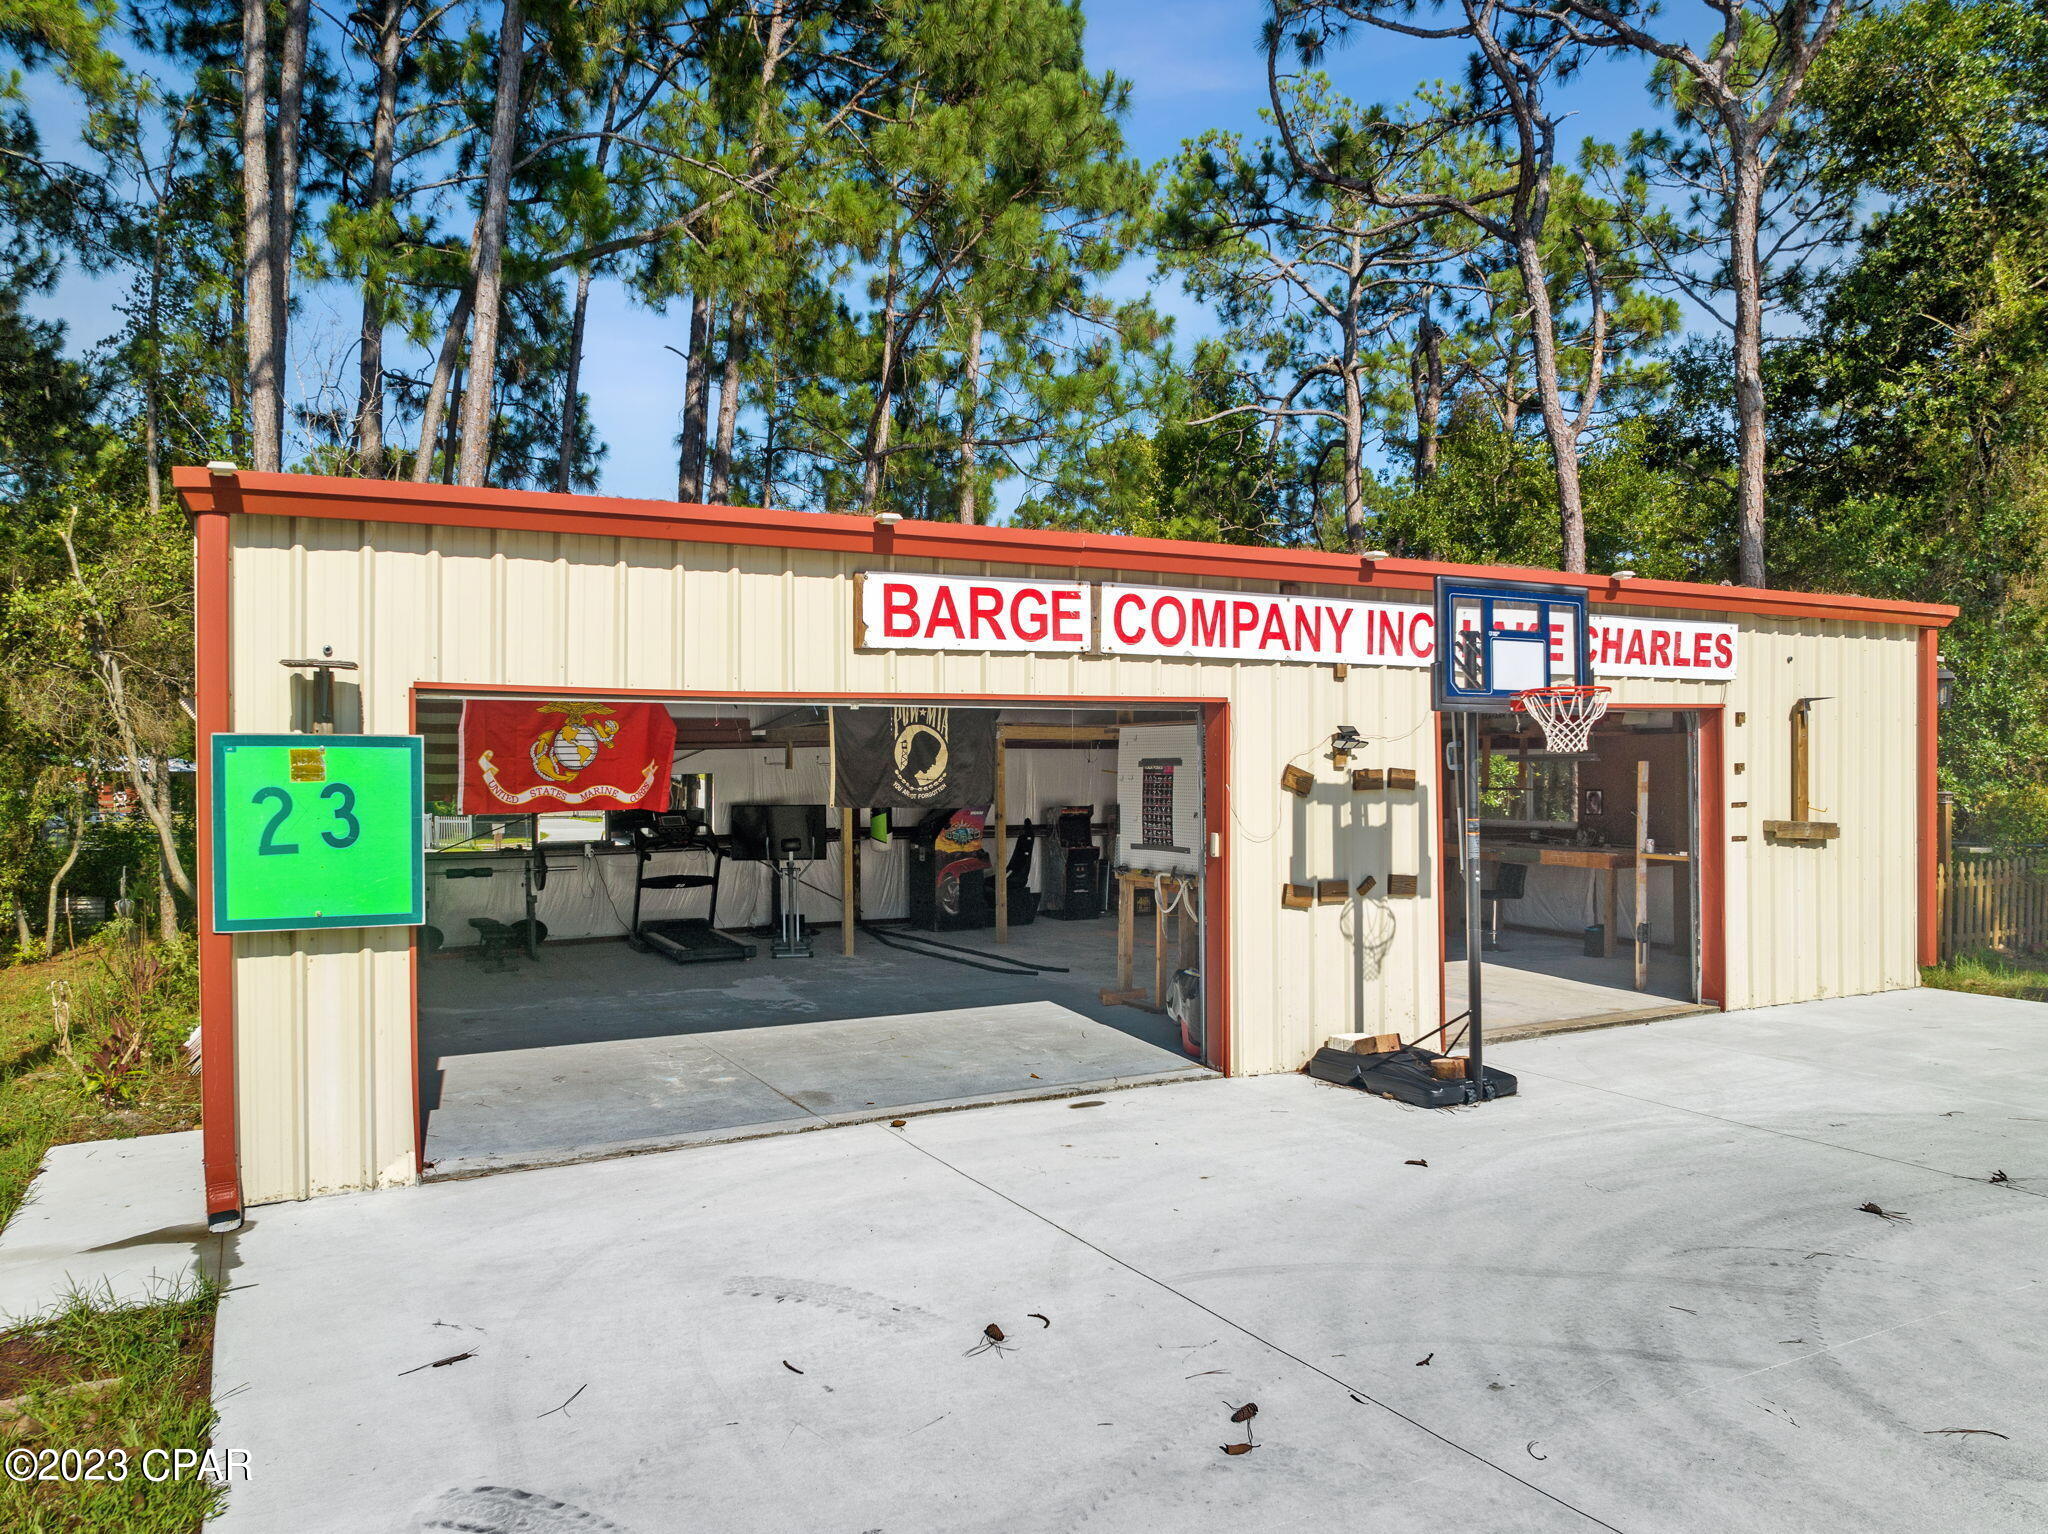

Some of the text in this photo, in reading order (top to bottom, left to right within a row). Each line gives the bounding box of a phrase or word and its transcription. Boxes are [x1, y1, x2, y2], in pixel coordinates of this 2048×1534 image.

[883, 583, 1083, 642] BARGE
[1114, 594, 1354, 654] COMPANY
[1367, 610, 1437, 658] INC
[488, 780, 650, 804] UNITED STATES MARINE CORPS
